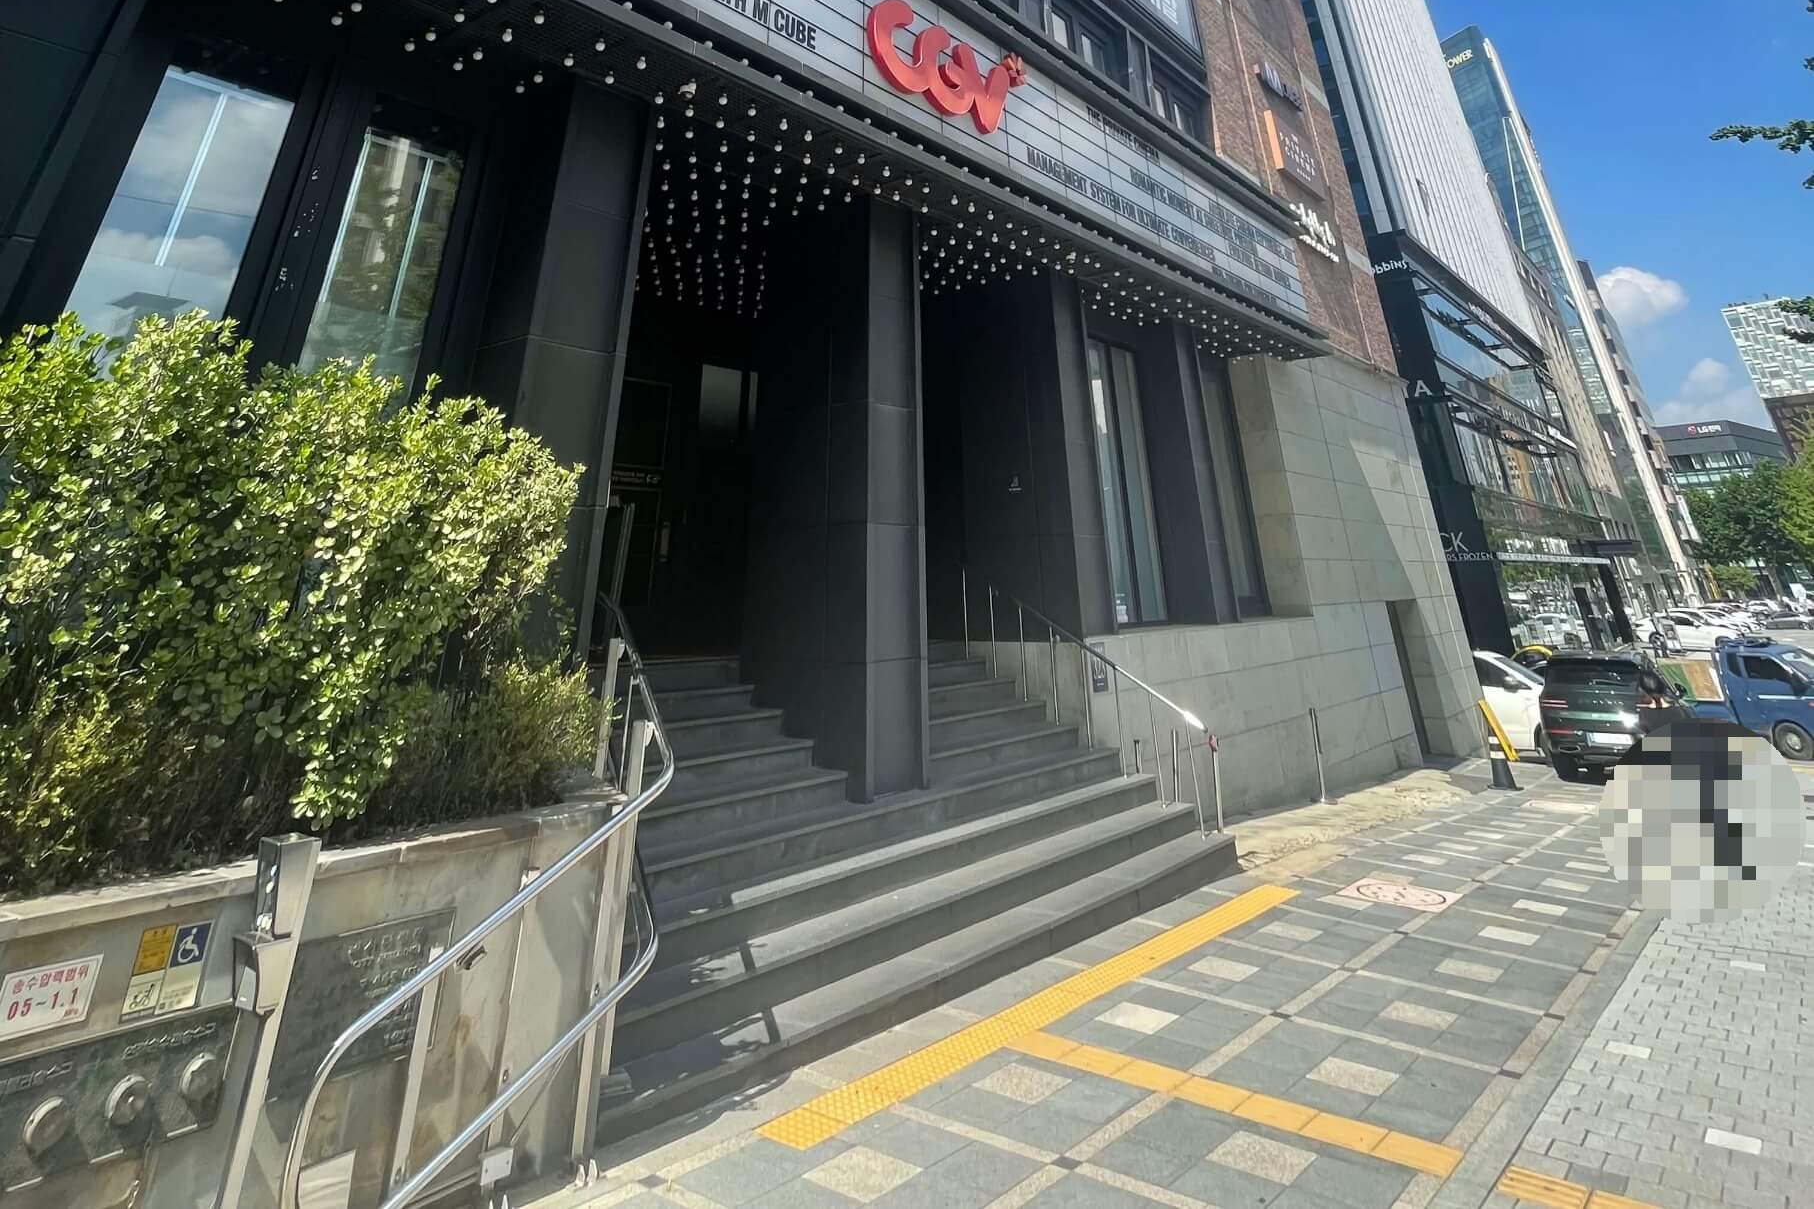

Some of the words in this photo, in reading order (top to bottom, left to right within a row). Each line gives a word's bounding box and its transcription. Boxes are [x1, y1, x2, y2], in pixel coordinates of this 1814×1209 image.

[774, 8, 817, 50] CUBE
[1026, 146, 1087, 195] MANAGEMENT
[1089, 181, 1121, 213] SYSTEM
[1121, 198, 1136, 220] FOR
